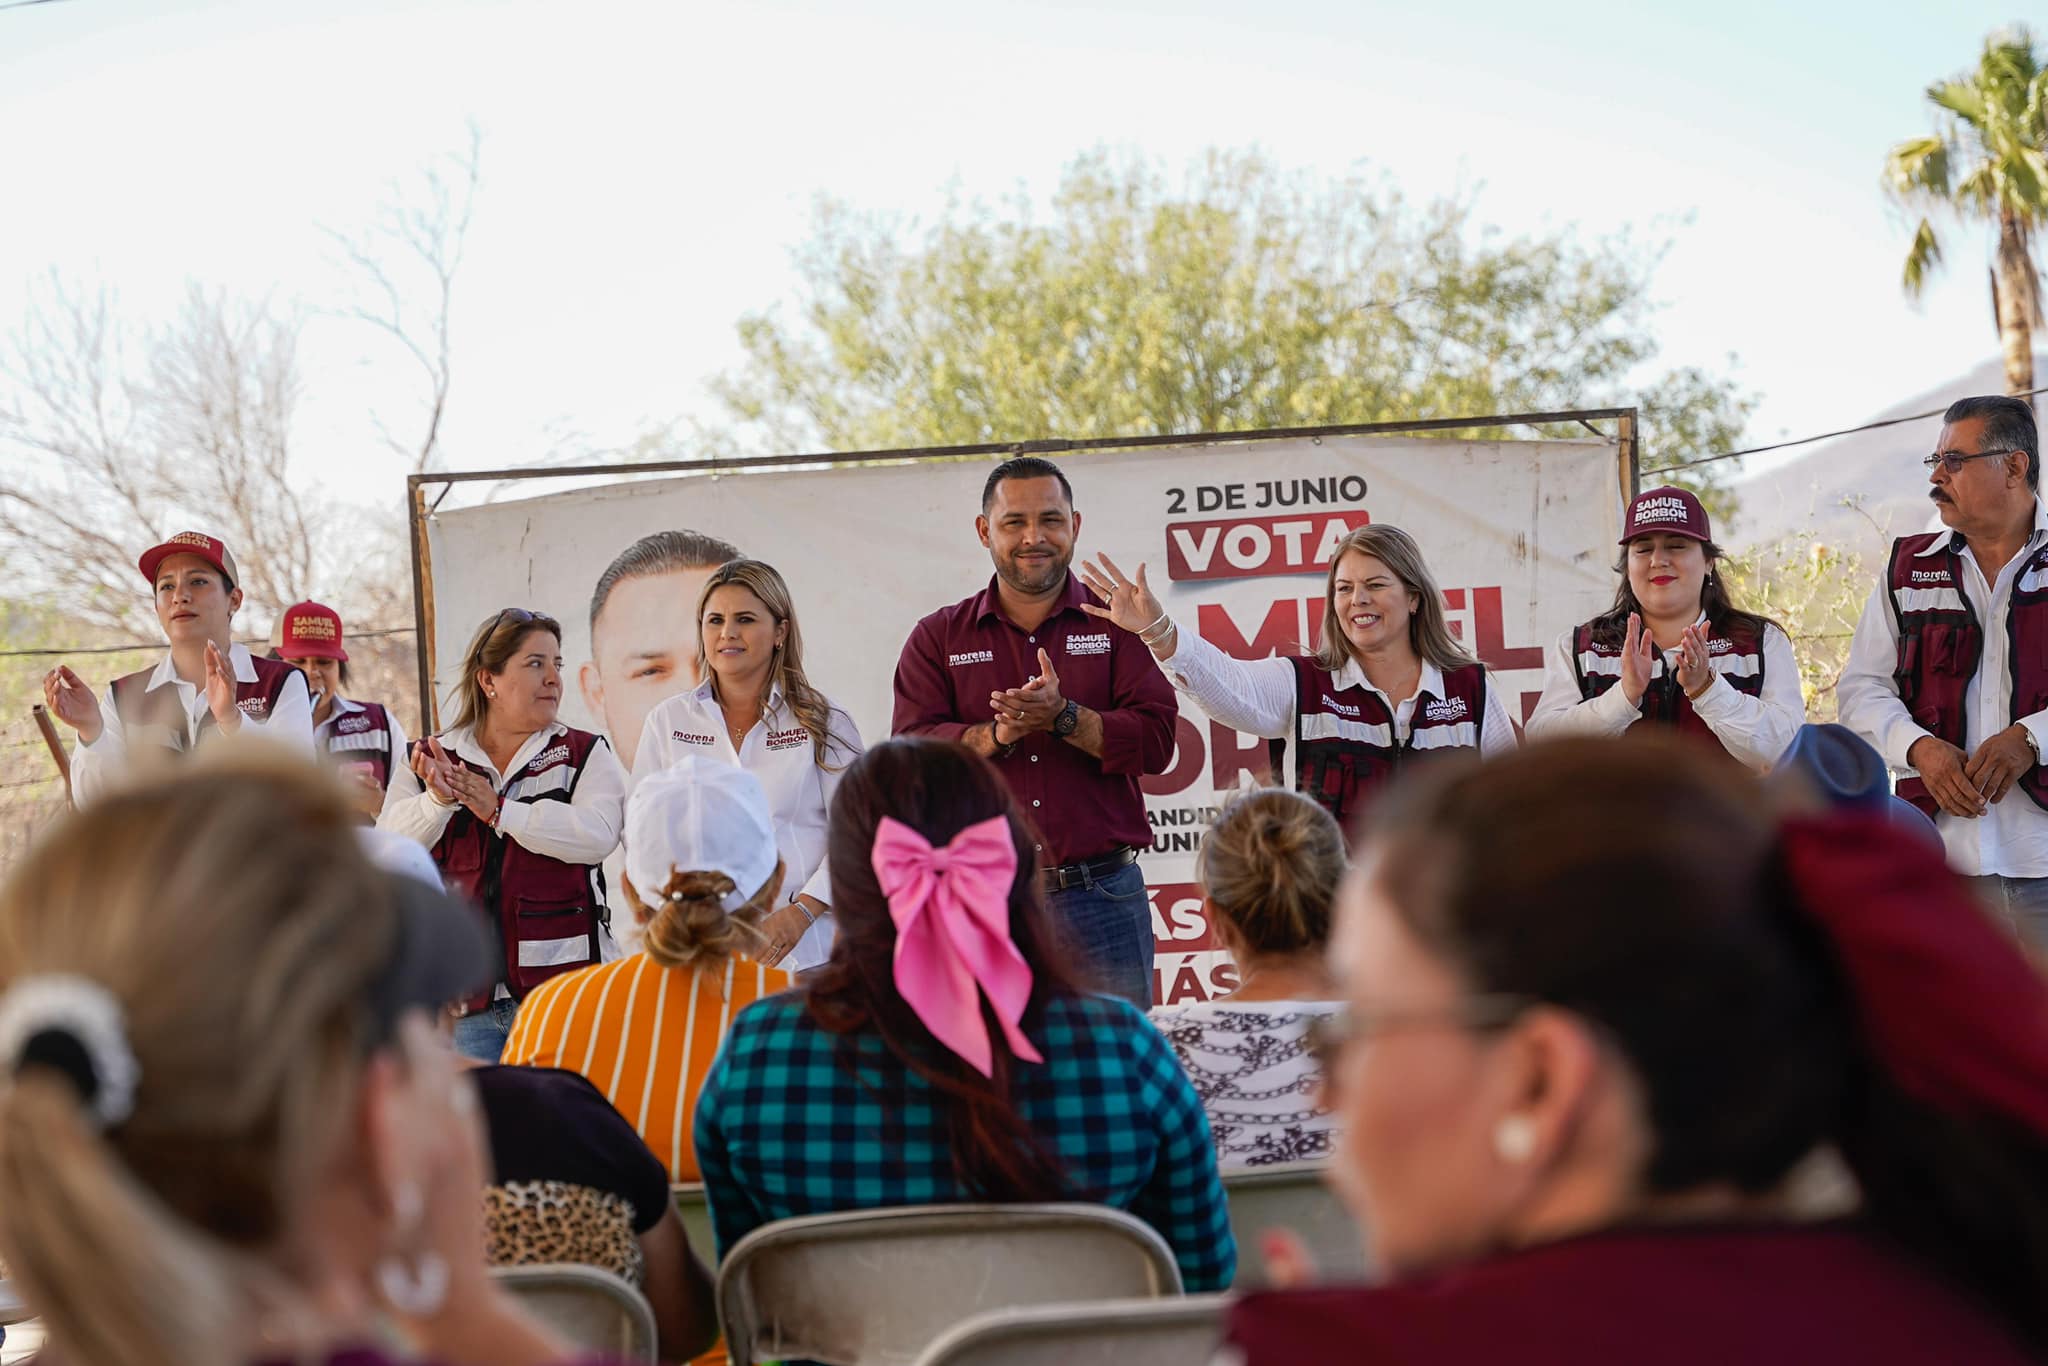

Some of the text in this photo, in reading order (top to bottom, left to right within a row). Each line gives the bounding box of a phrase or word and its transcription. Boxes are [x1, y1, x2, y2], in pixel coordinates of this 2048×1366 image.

[1165, 475, 1367, 514] 2 DE JUNIO
[1636, 497, 1687, 512] SAMUEL
[1634, 507, 1688, 522] BORBON
[1171, 518, 1353, 572] VOTA
[1066, 633, 1111, 643] SAMUEL
[1066, 641, 1111, 650] BORBON
[949, 650, 993, 662] morena
[673, 731, 715, 742] morena
[767, 728, 807, 739] SAMUEL
[766, 735, 808, 747] BORBON
[1147, 889, 1207, 940] ÁS
